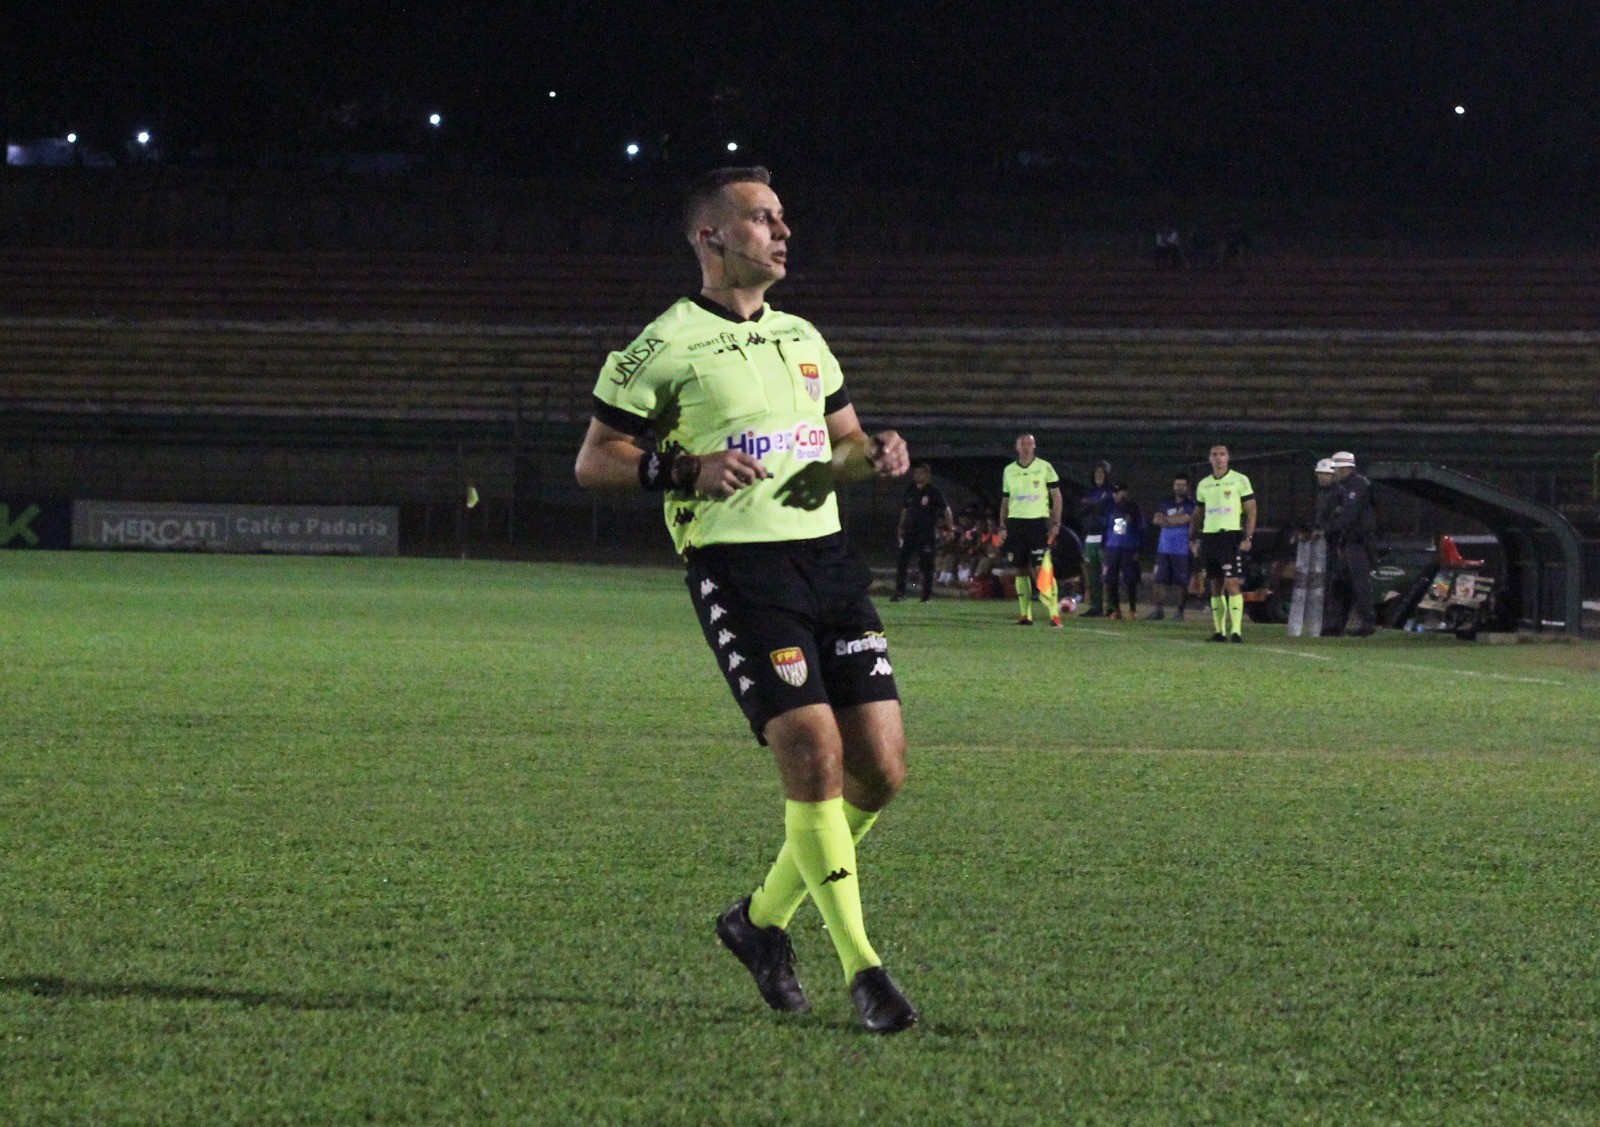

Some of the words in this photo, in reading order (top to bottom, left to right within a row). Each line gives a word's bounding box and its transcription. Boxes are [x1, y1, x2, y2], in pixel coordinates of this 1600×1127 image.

[609, 338, 665, 388] UNISA
[101, 519, 217, 544] MERCATI
[235, 517, 281, 535] Café
[288, 522, 301, 535] e
[306, 518, 388, 536] Padaria
